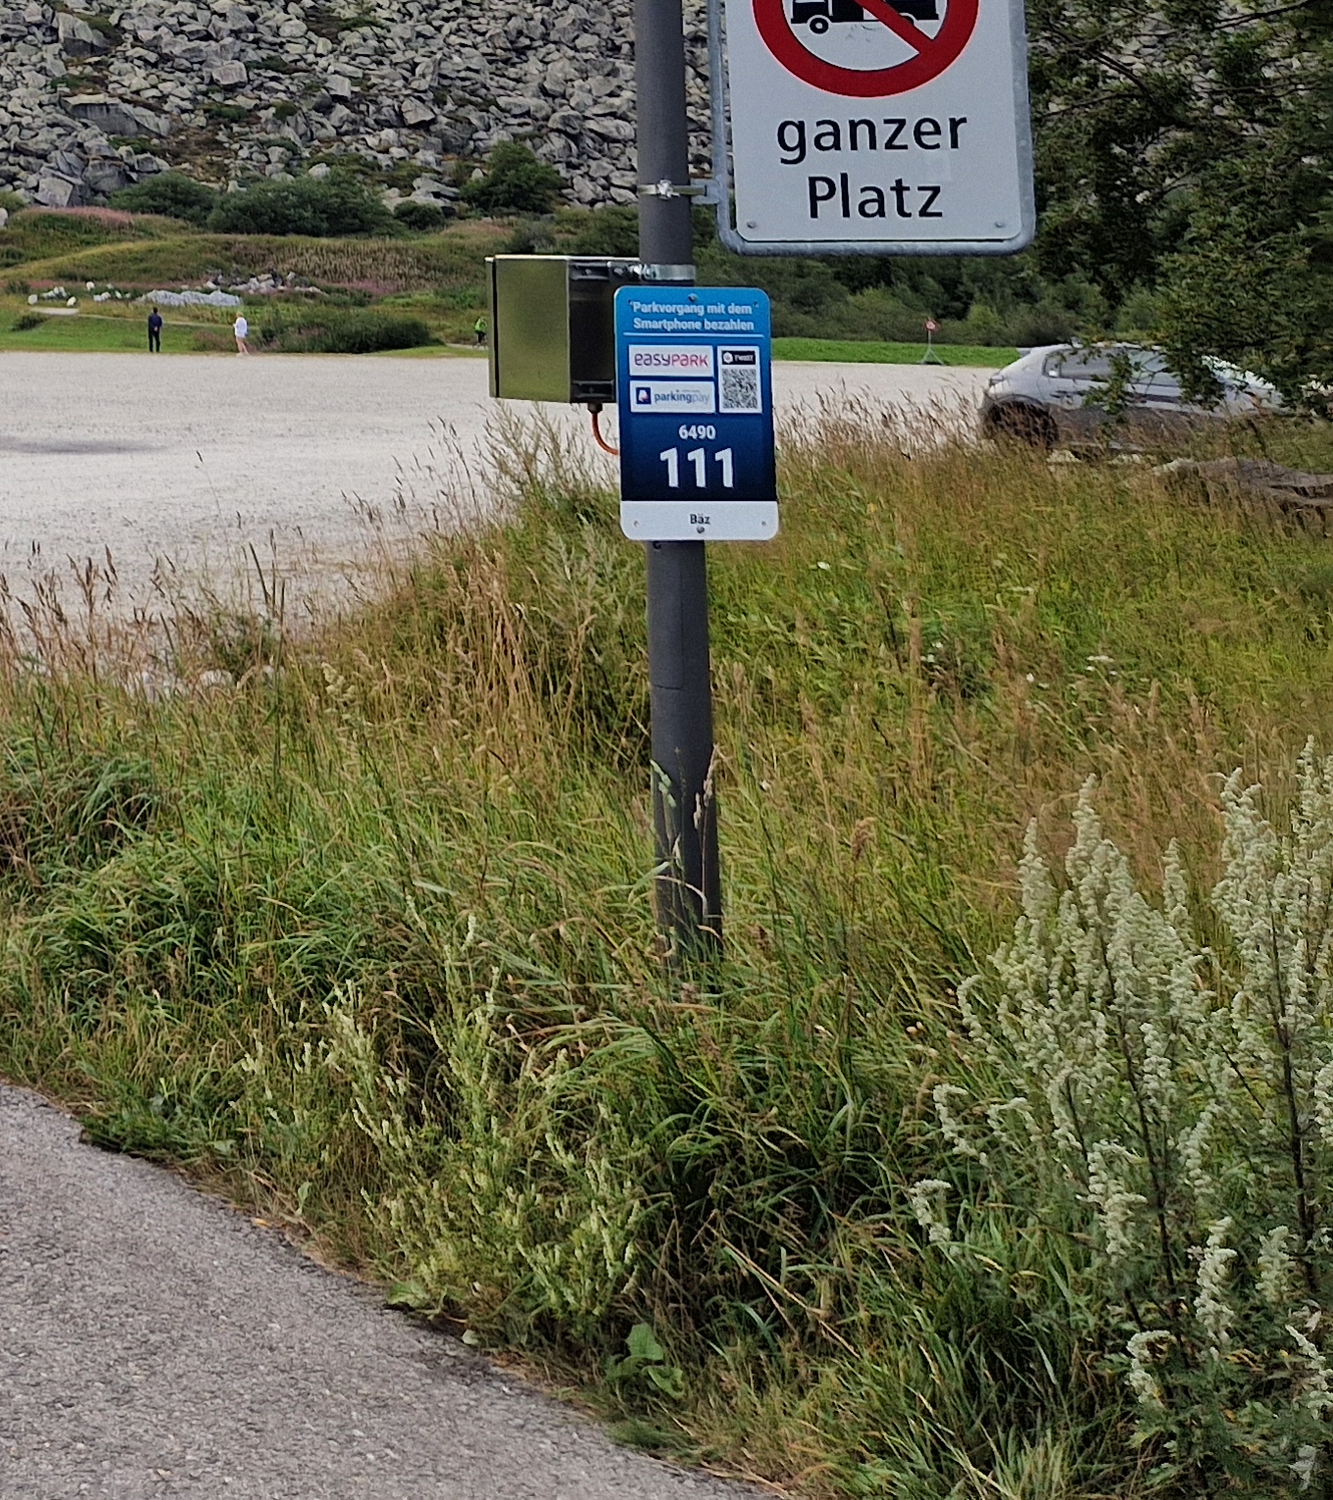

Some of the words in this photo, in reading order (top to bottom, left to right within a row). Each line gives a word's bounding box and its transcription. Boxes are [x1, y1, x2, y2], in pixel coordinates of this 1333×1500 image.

[776, 114, 967, 165] ganzer
[807, 172, 944, 219] Platz
[633, 301, 705, 316] Parkvorgang
[707, 302, 725, 314] mit
[727, 302, 753, 315] dem
[633, 317, 702, 332] Smartphone
[704, 318, 754, 331] bezahlen
[678, 424, 716, 440] 6490
[659, 447, 734, 488] 111
[689, 513, 711, 525] Bäz
